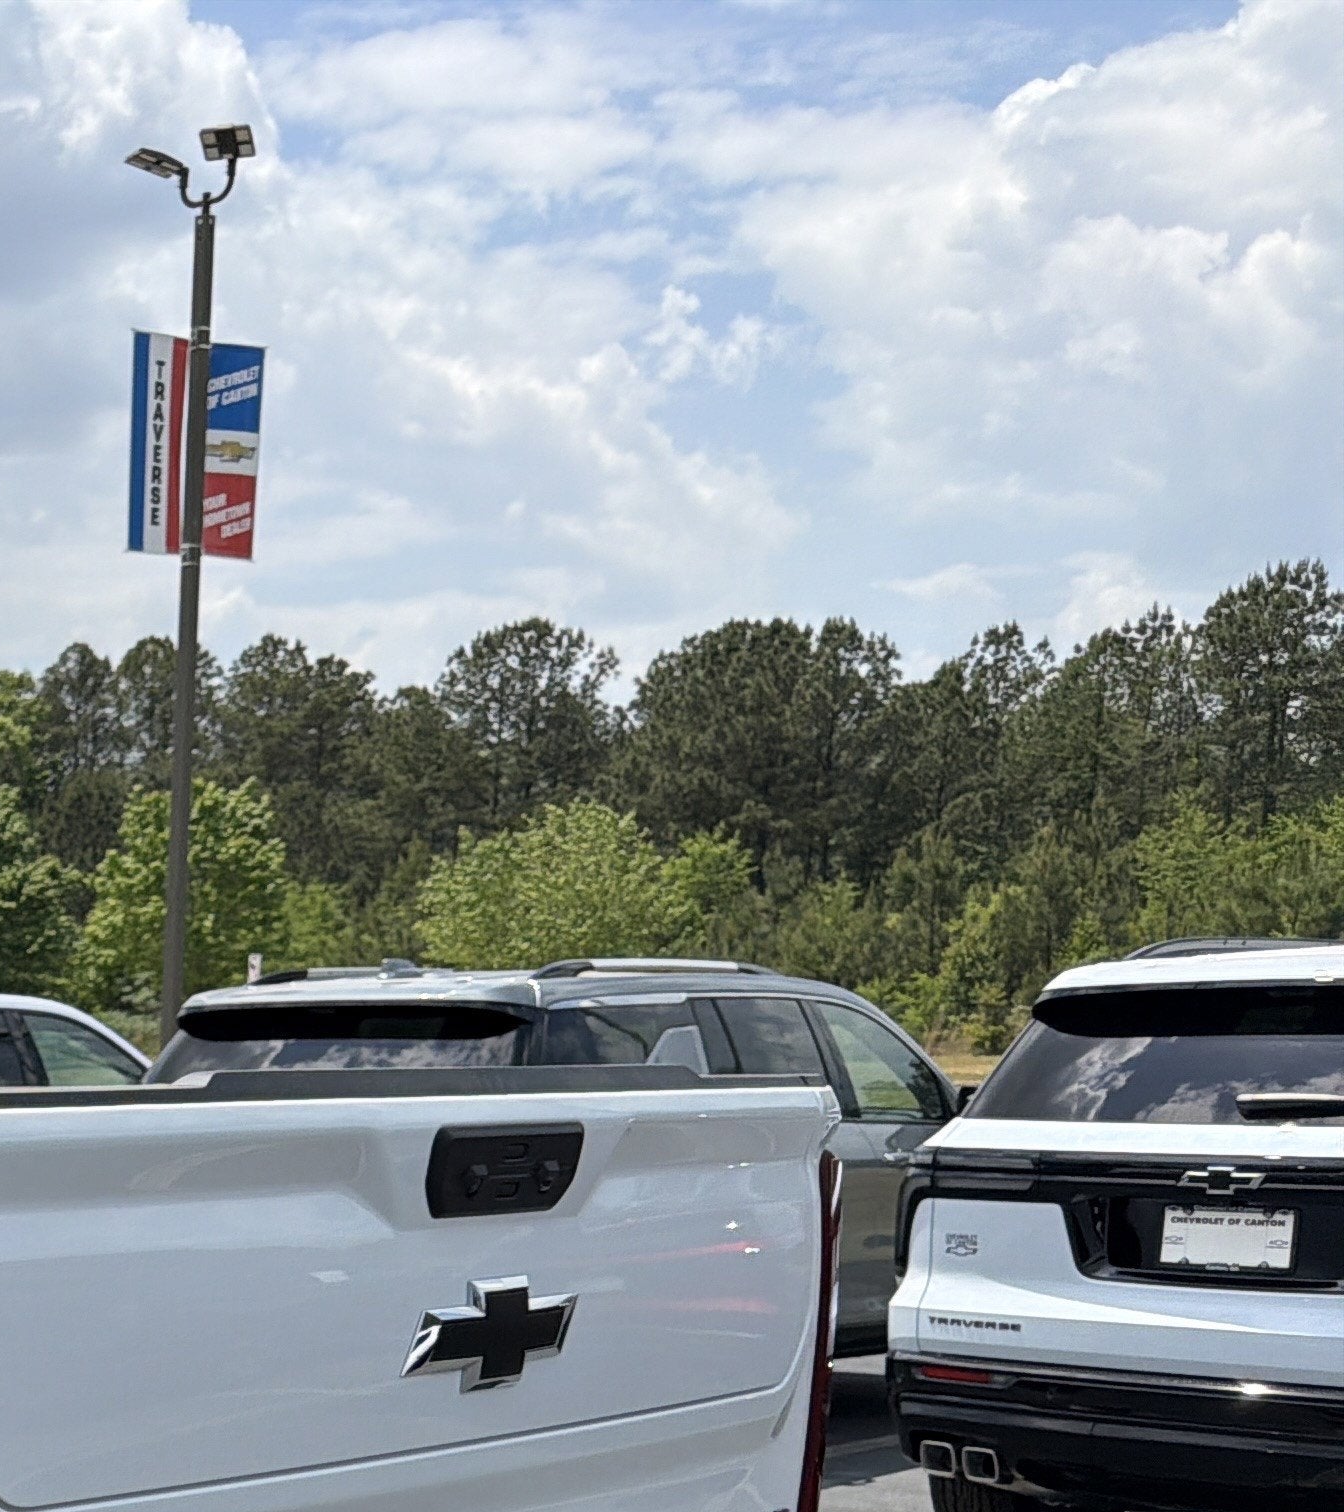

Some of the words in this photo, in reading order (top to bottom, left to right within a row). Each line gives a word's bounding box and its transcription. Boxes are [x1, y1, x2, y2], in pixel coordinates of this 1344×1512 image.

[150, 359, 166, 526] TRAVERSE
[1170, 1216, 1225, 1225] CHEVROLET
[1244, 1217, 1286, 1227] CANTON
[929, 1316, 1021, 1332] TRAVERSE
